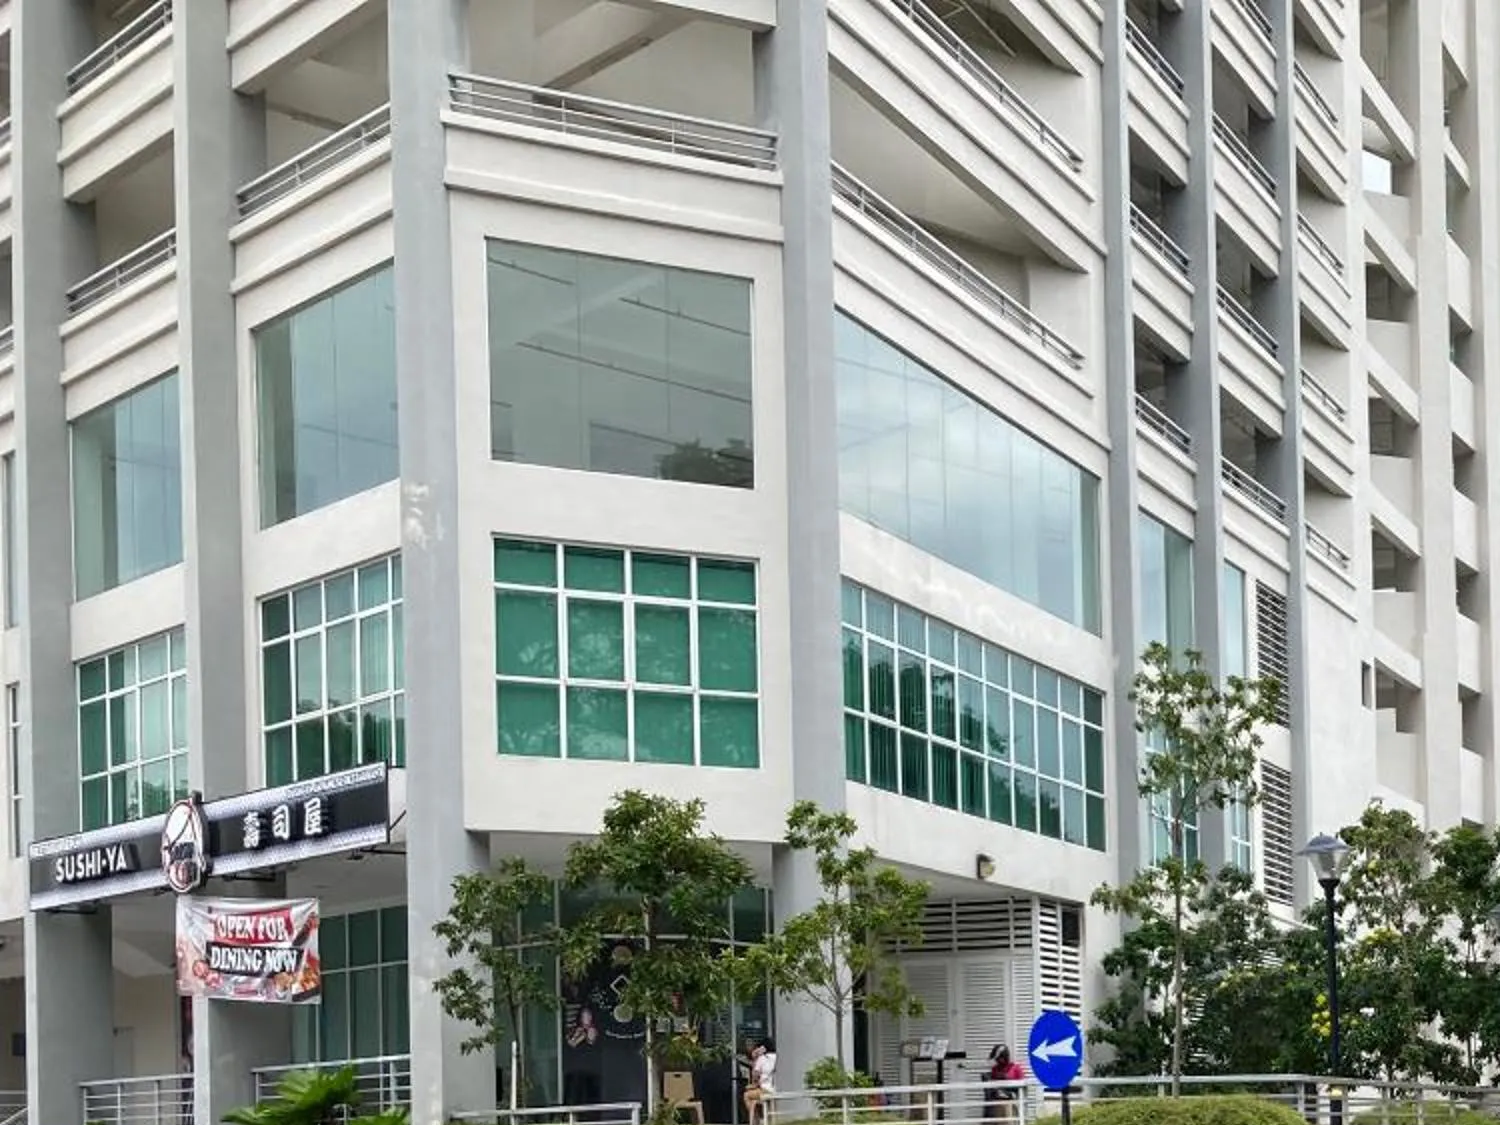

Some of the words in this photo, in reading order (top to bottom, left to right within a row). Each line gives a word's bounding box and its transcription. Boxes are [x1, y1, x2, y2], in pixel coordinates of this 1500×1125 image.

[217, 914, 255, 940] OPEN
[258, 914, 289, 941] FOR
[210, 945, 262, 971] DINING
[264, 948, 298, 973] NOW
